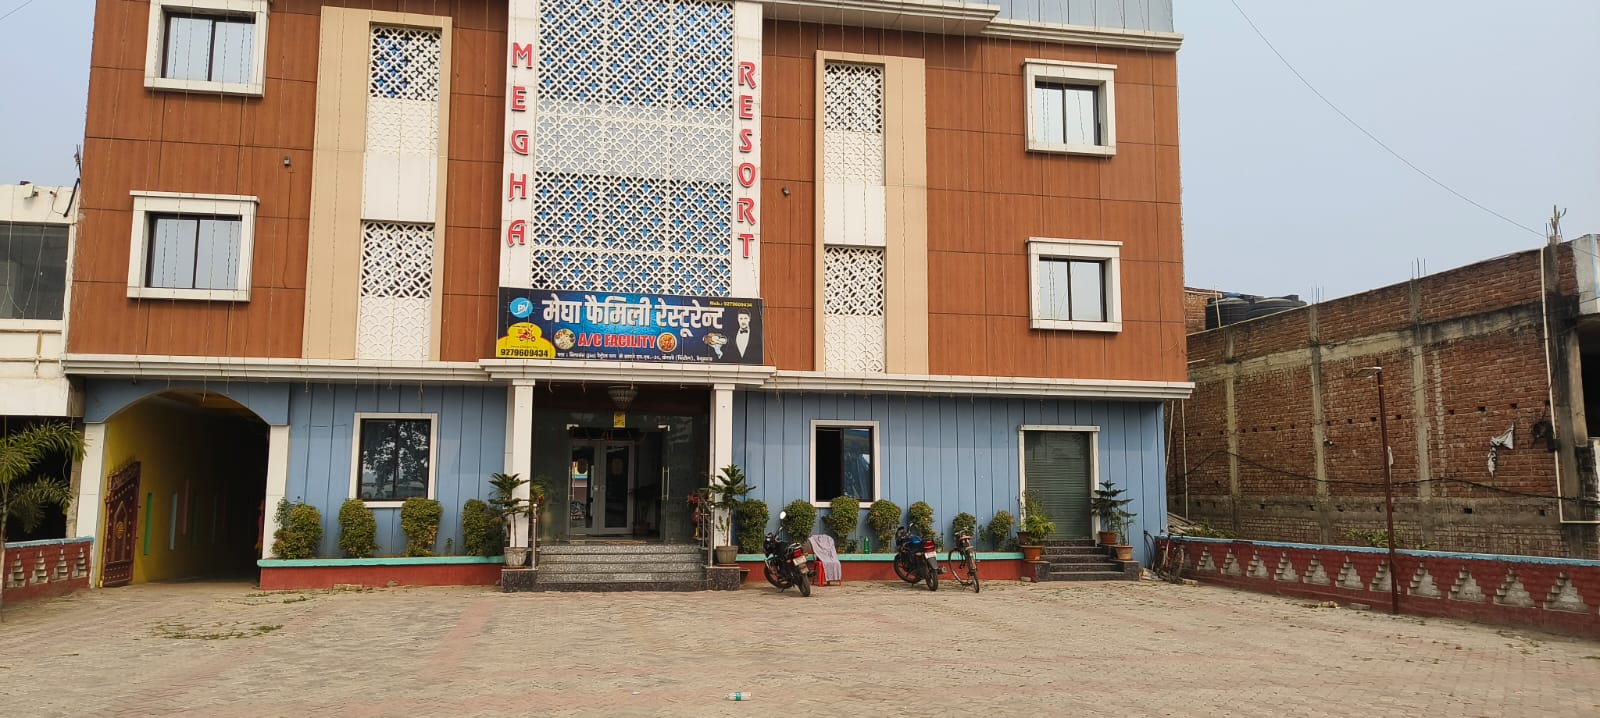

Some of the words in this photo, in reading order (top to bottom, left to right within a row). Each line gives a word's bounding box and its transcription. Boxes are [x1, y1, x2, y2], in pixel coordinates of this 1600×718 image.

[507, 42, 533, 247] MEGHA
[737, 61, 757, 258] RESORT
[541, 293, 582, 324] मेघा
[584, 294, 652, 327] फैमिली
[500, 348, 549, 358] 9279609434
[577, 332, 602, 347] A/C
[604, 334, 657, 349] FACILITY
